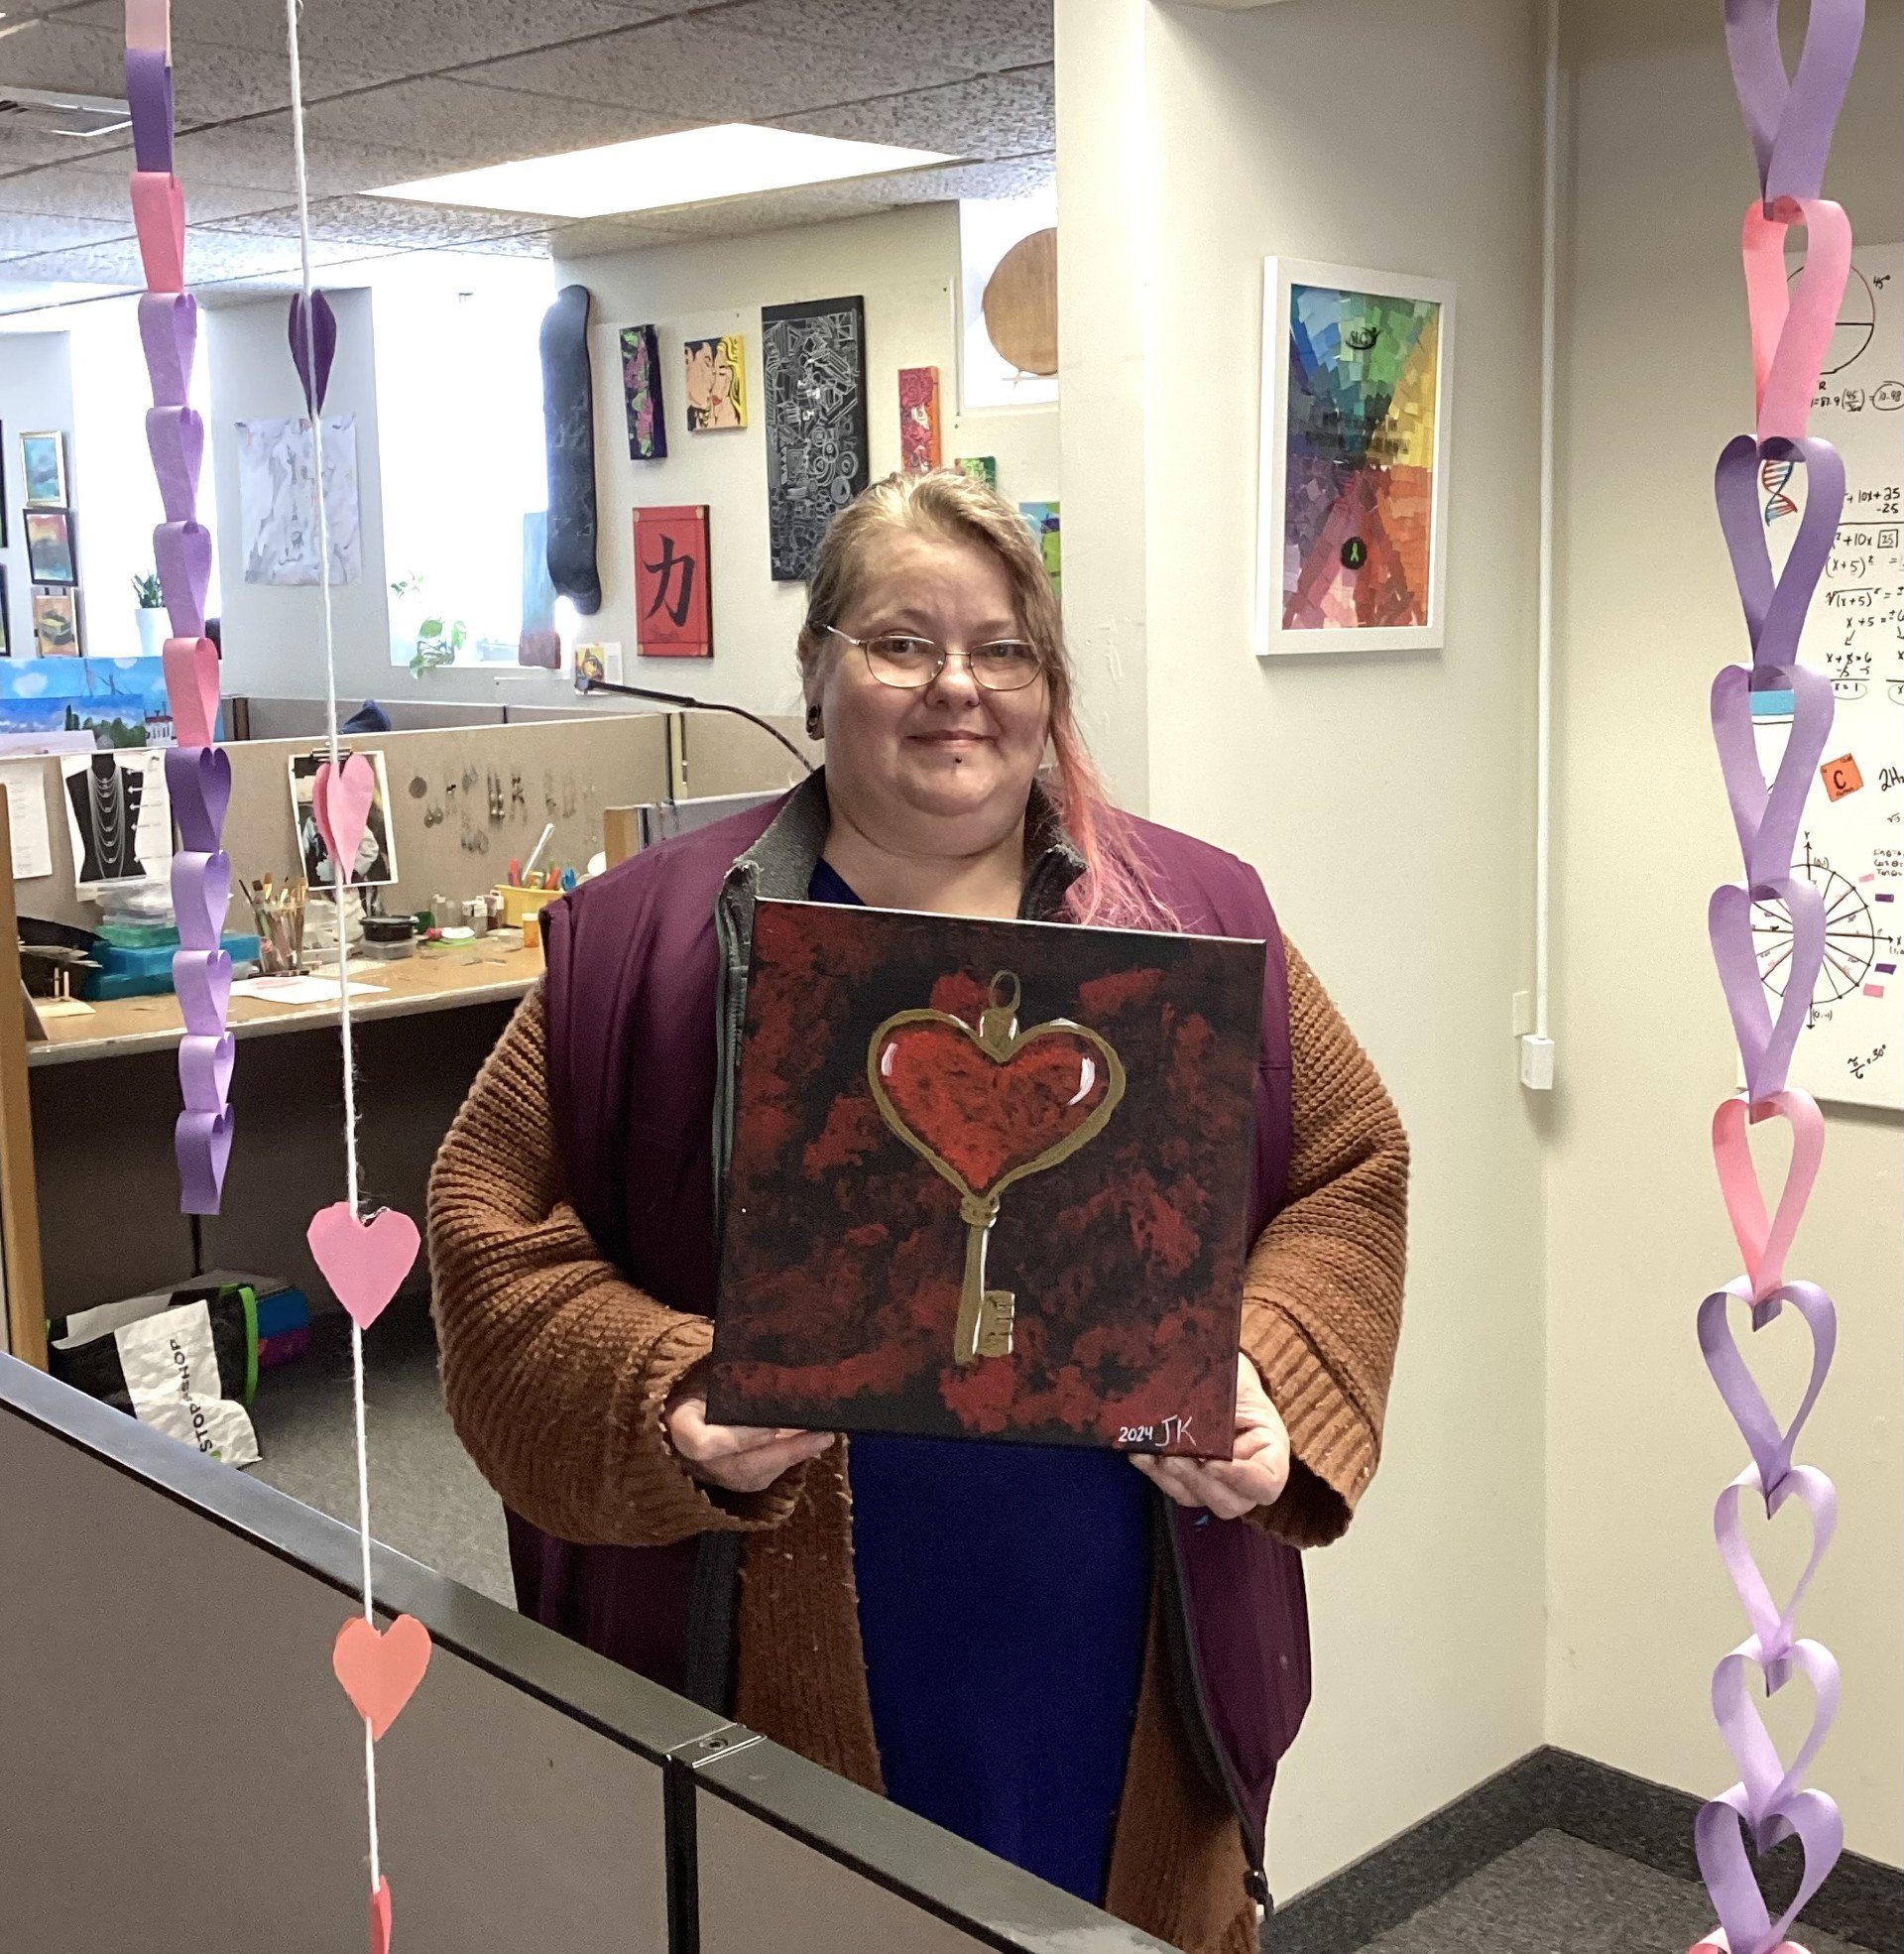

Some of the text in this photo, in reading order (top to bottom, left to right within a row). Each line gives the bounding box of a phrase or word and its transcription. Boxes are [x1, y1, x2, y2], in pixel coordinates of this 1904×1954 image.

[643, 533, 696, 628] 力
[1833, 770, 1846, 790] C
[1118, 1413, 1197, 1446] 2024 JK
